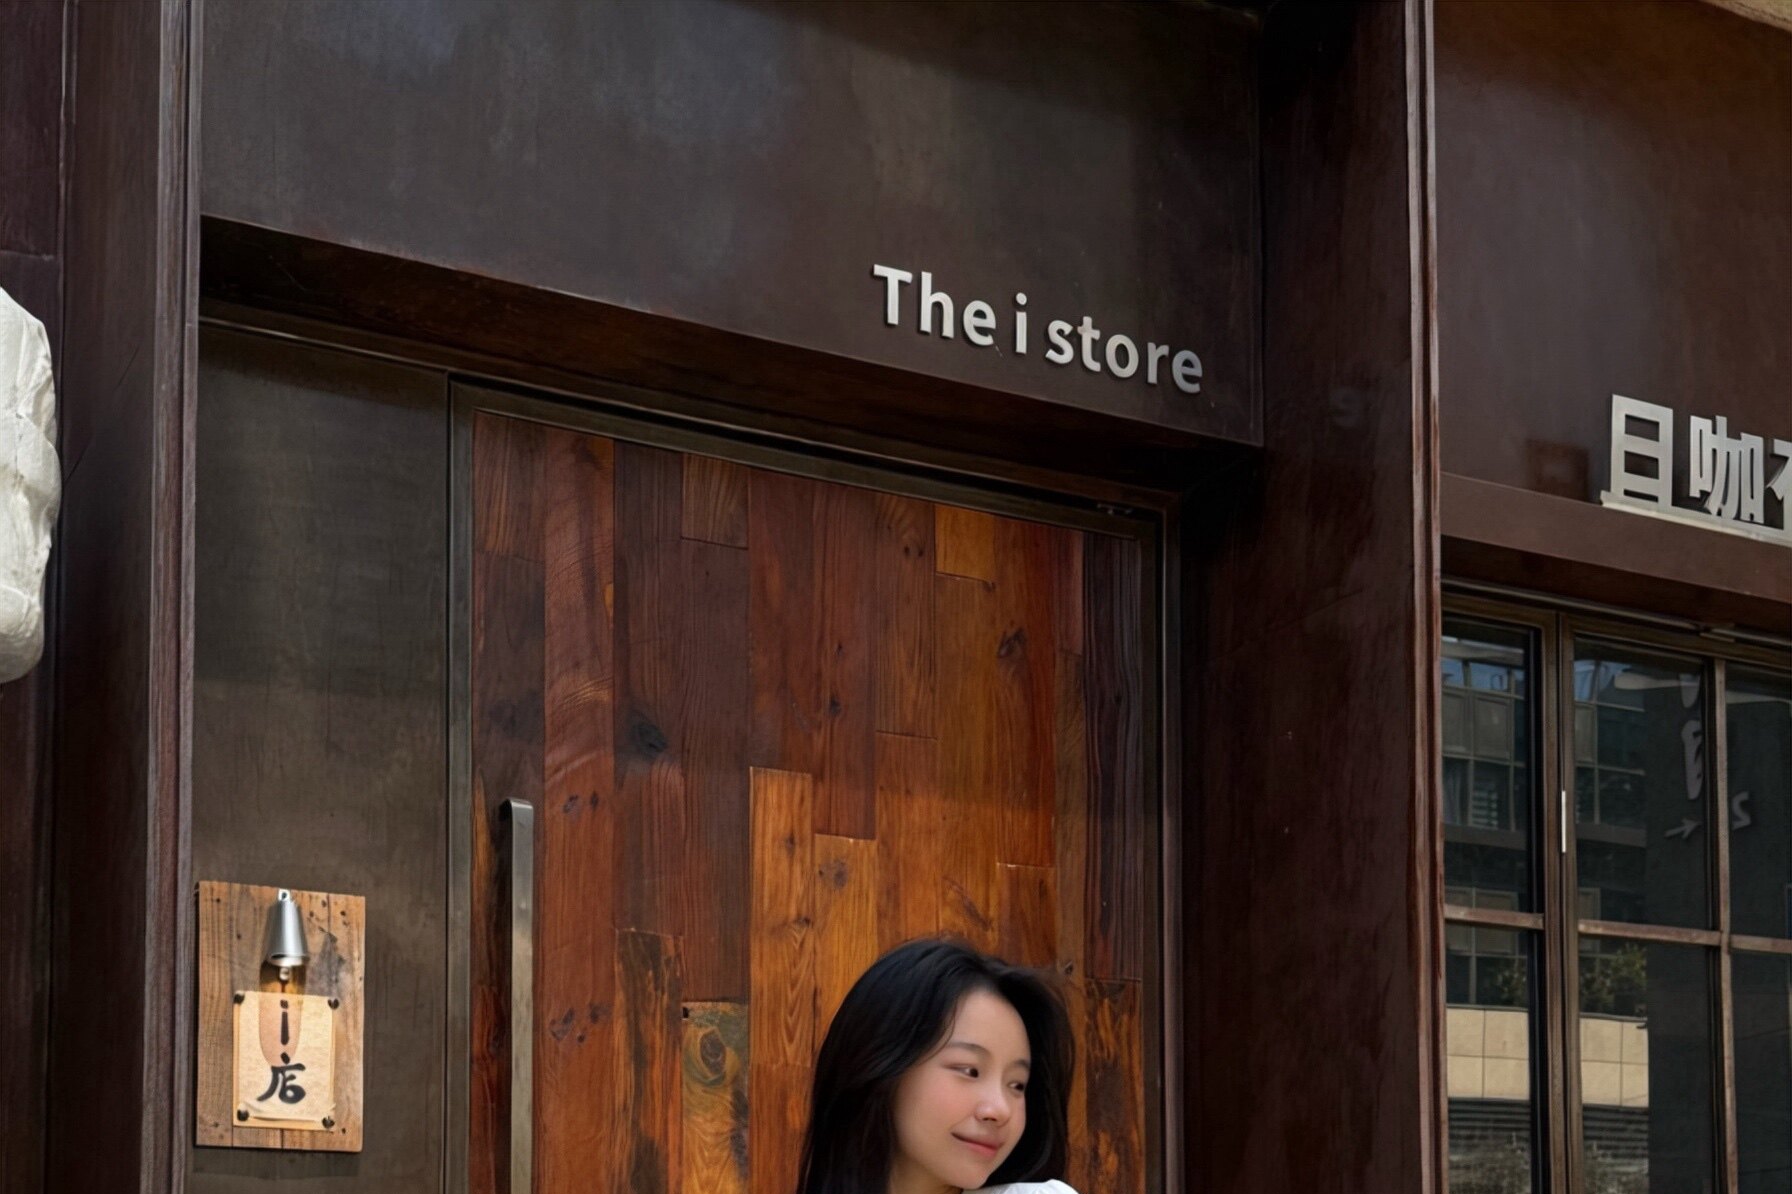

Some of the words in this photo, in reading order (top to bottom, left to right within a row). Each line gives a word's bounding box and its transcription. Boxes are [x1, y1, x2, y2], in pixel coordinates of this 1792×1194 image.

[873, 264, 996, 346] The
[1015, 292, 1028, 354] i
[1045, 316, 1202, 394] store
